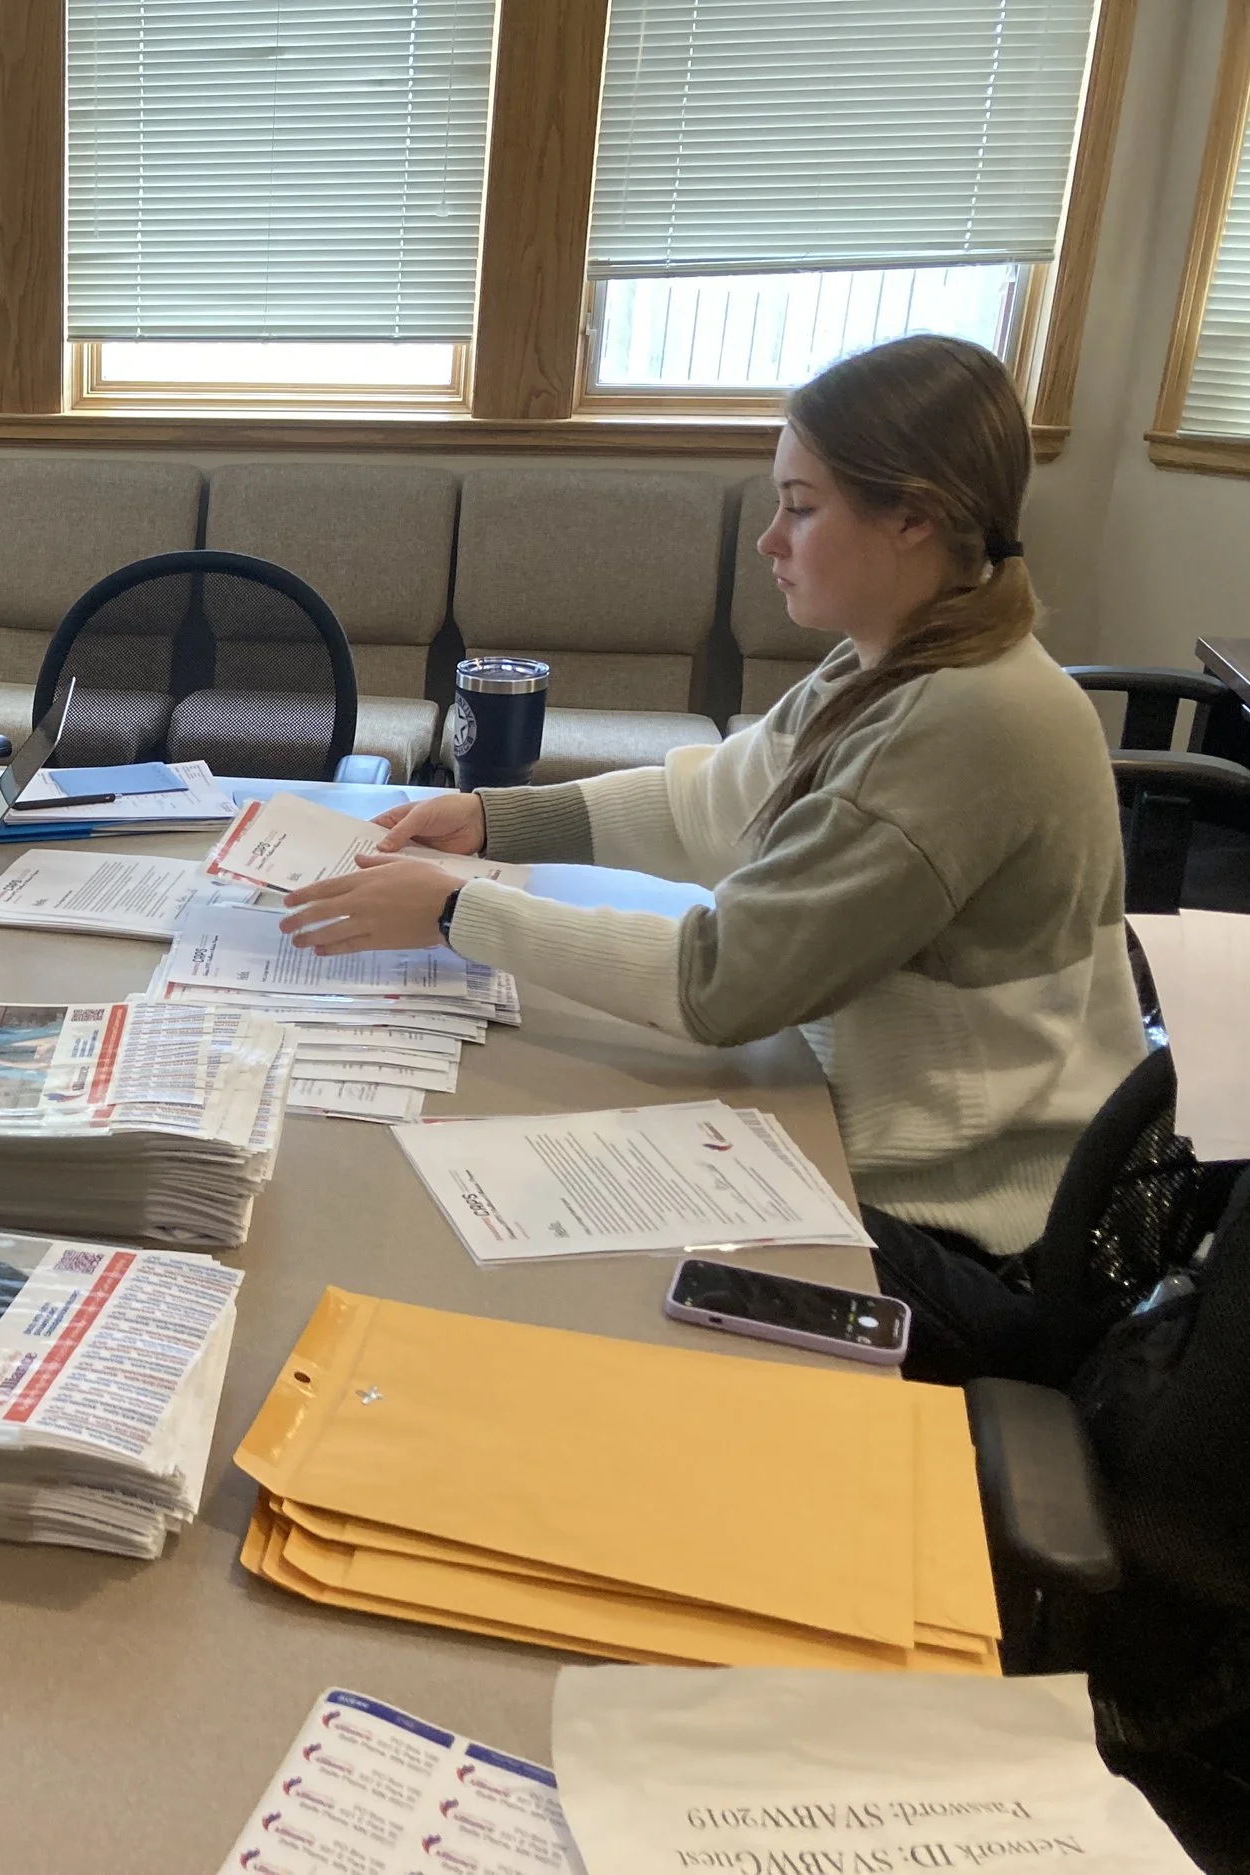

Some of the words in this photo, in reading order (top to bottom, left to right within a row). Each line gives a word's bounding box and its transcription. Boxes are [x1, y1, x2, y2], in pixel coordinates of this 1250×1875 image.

[892, 1801, 1034, 1826] Password:
[901, 1841, 955, 1869] ID:
[958, 1833, 1087, 1867] Network
